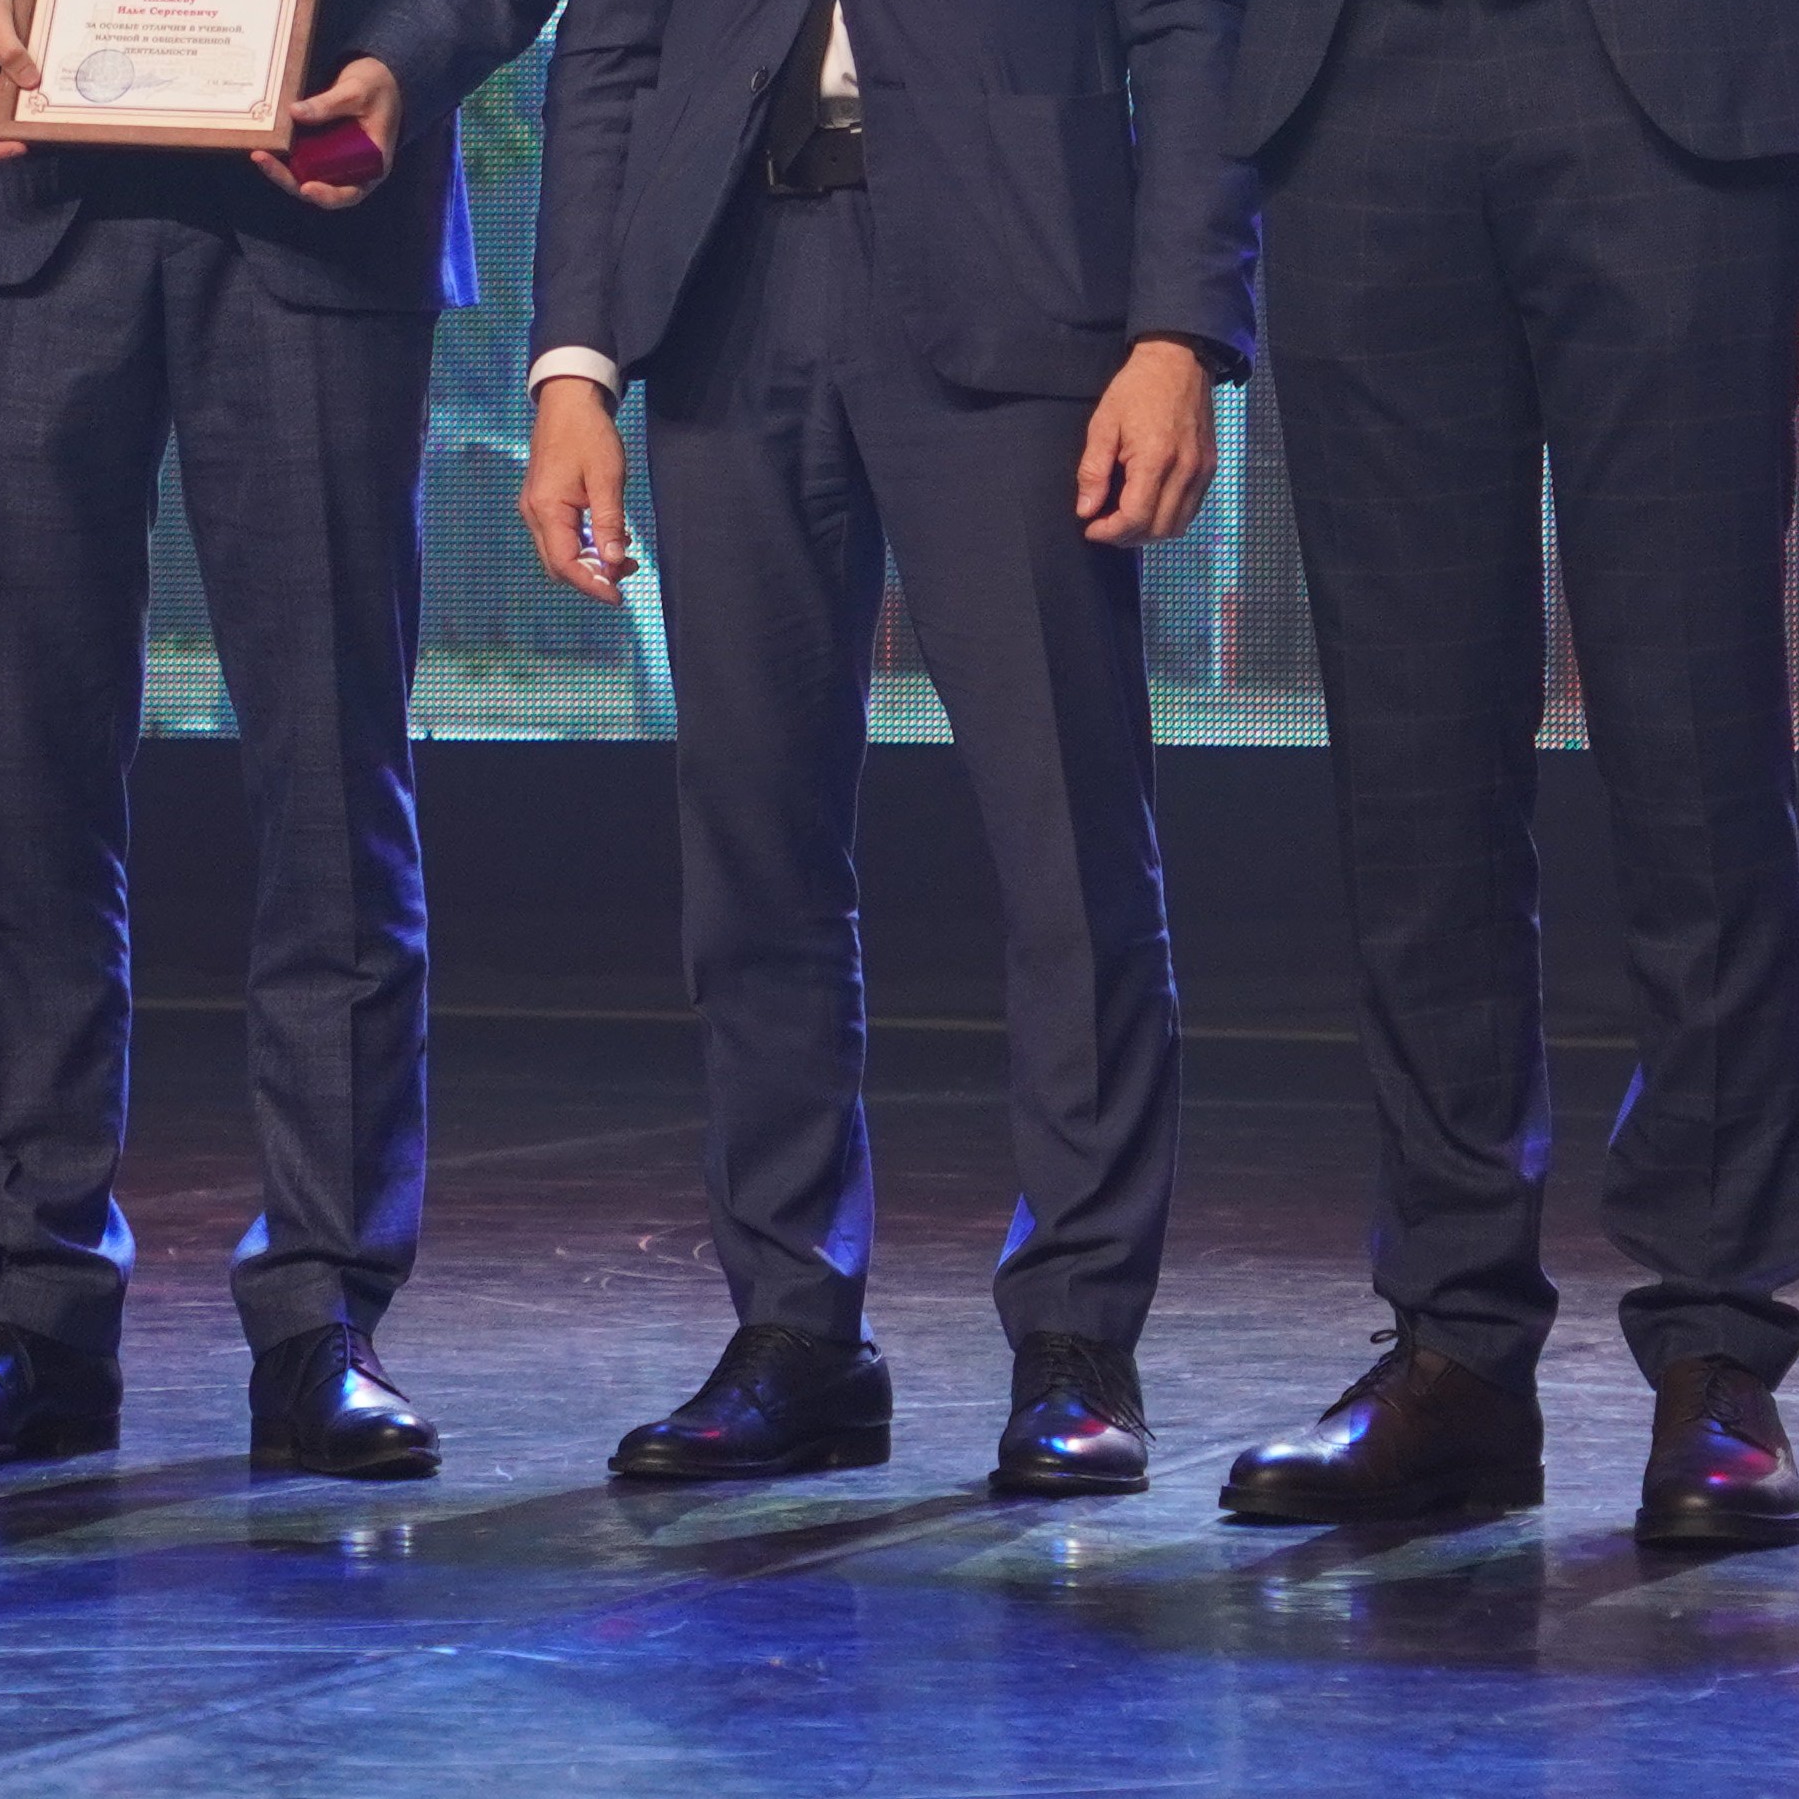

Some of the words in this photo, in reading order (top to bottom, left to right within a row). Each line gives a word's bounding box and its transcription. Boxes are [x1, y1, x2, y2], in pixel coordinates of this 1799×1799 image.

[117, 6, 146, 15] Илье
[149, 6, 219, 18] Сергеевичу
[99, 22, 139, 30] ОСОБЫЕ
[142, 23, 186, 32] ОТЛИЧИЯ
[95, 33, 140, 42] НАУЧНОЙ
[151, 35, 231, 45] ОБЩЕСТВЕННОЙ
[123, 47, 198, 56] ДЕЯТЕЛЬНОСТИ
